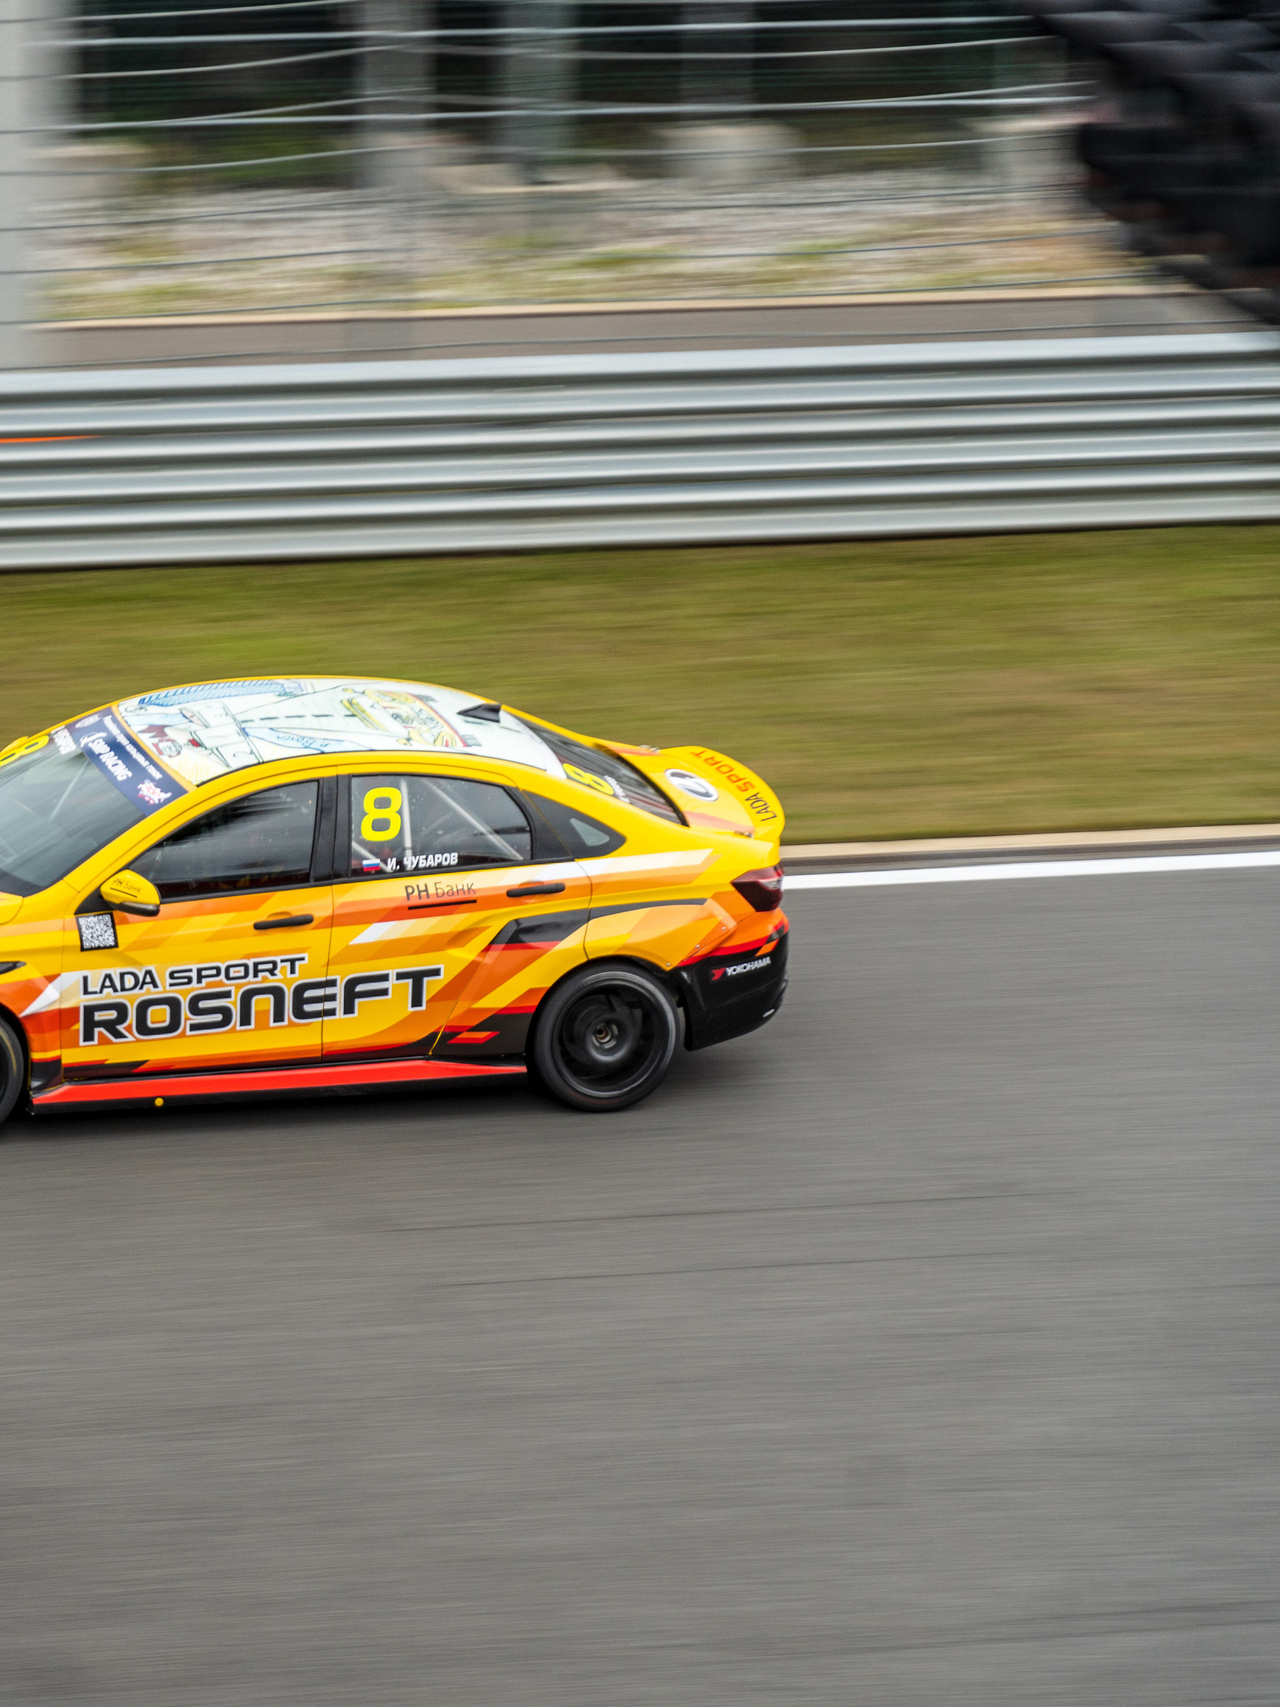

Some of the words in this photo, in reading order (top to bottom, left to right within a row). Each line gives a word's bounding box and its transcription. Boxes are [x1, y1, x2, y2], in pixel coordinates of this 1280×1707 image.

[99, 751, 132, 781] RACING
[563, 763, 614, 795] 8
[691, 750, 755, 793] SPORT
[361, 787, 402, 841] 8
[745, 792, 778, 822] LADA
[403, 852, 459, 870] ЧУБАРОВ
[434, 881, 477, 898] Банк
[81, 968, 160, 997] LADA
[168, 954, 308, 990] SPORT
[726, 957, 771, 976] YOKOHAMA
[81, 966, 443, 1045] ROSNEFT
